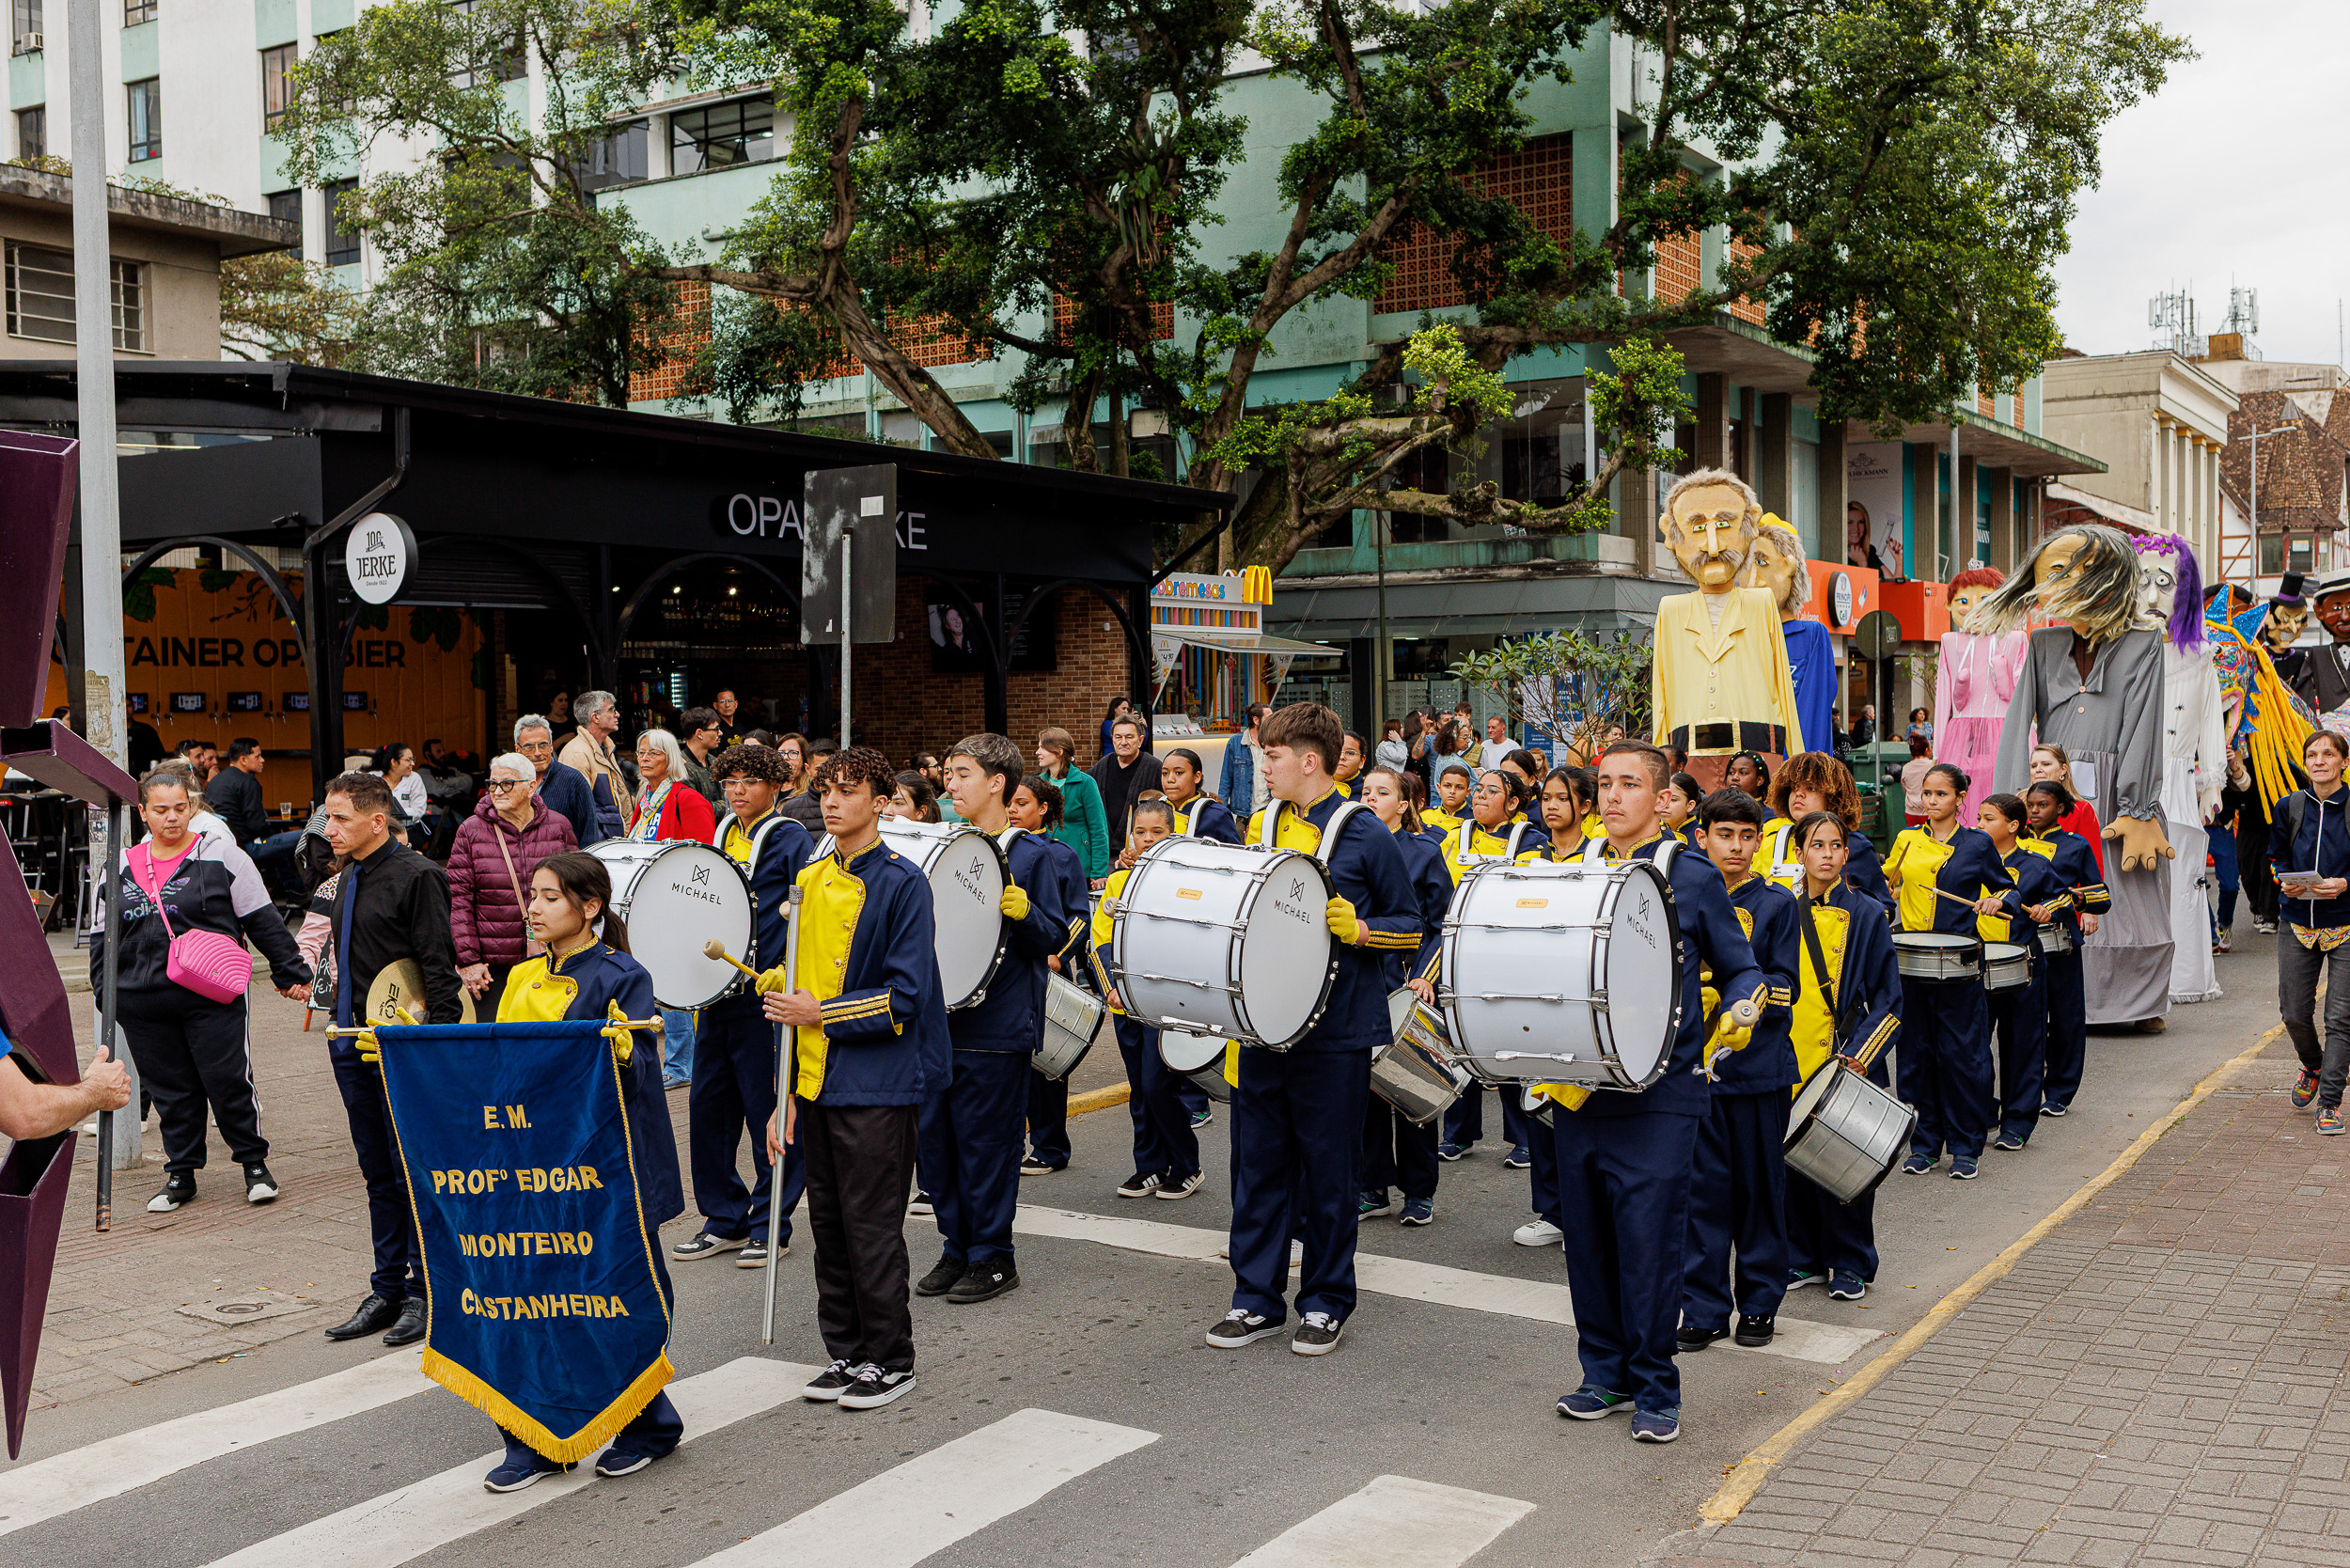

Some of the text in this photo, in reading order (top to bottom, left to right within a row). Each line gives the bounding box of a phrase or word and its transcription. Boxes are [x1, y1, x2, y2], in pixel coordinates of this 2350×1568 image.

[728, 494, 804, 541] OPA
[356, 555, 397, 581] JERKE
[671, 882, 722, 905] MICHAEL
[954, 869, 986, 905] MICHAEL
[1274, 899, 1311, 924] MICHAEL
[1626, 913, 1657, 949] MICHAEL
[318, 957, 331, 977] PR
[384, 982, 400, 1019] EKO
[514, 1165, 604, 1193] EDGAR
[458, 1231, 594, 1258] MONTEIRO
[461, 1287, 630, 1321] CASTANHEIRA
